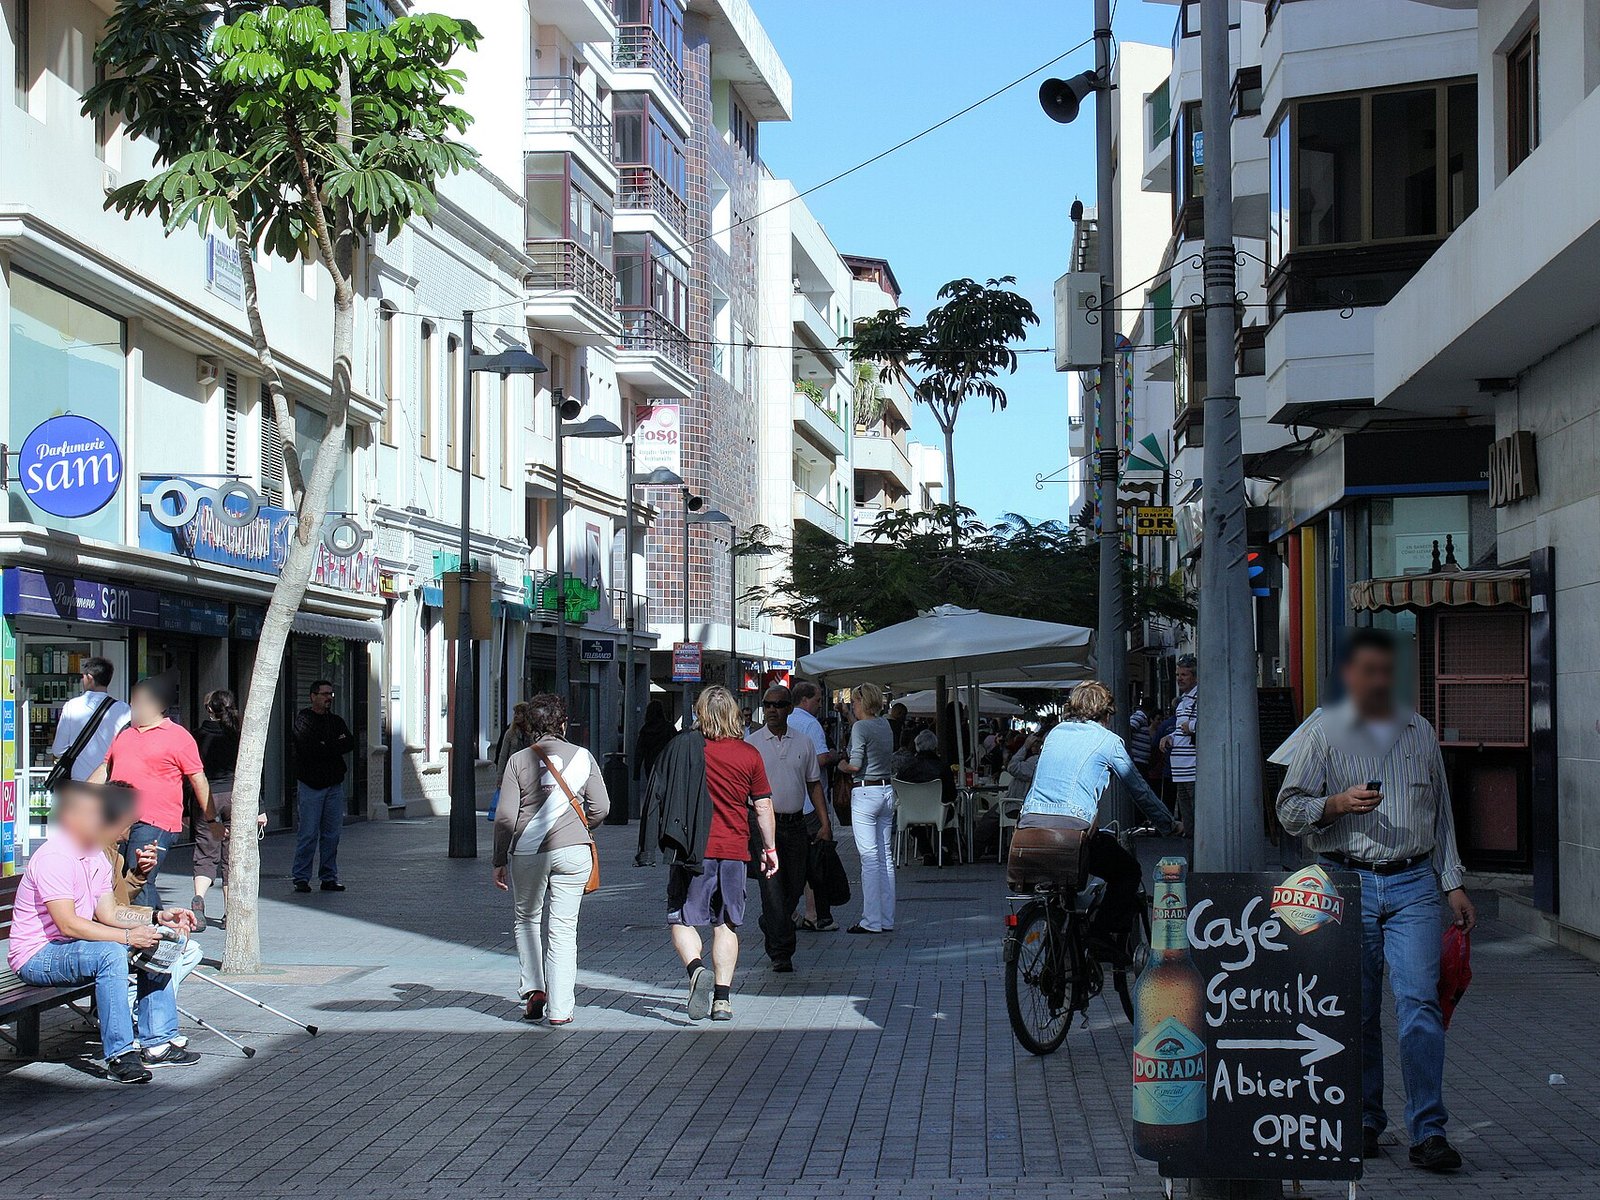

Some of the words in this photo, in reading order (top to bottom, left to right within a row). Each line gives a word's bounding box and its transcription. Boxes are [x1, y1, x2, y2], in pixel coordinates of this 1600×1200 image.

[36, 438, 106, 461] Parfumerie
[26, 452, 119, 494] sam
[101, 587, 130, 620] sam
[1273, 890, 1340, 915] DORADA
[1187, 896, 1289, 971] Café
[1136, 1056, 1204, 1079] DORADA
[1212, 1059, 1346, 1105] Abierto
[1253, 1114, 1342, 1151] OPEN
